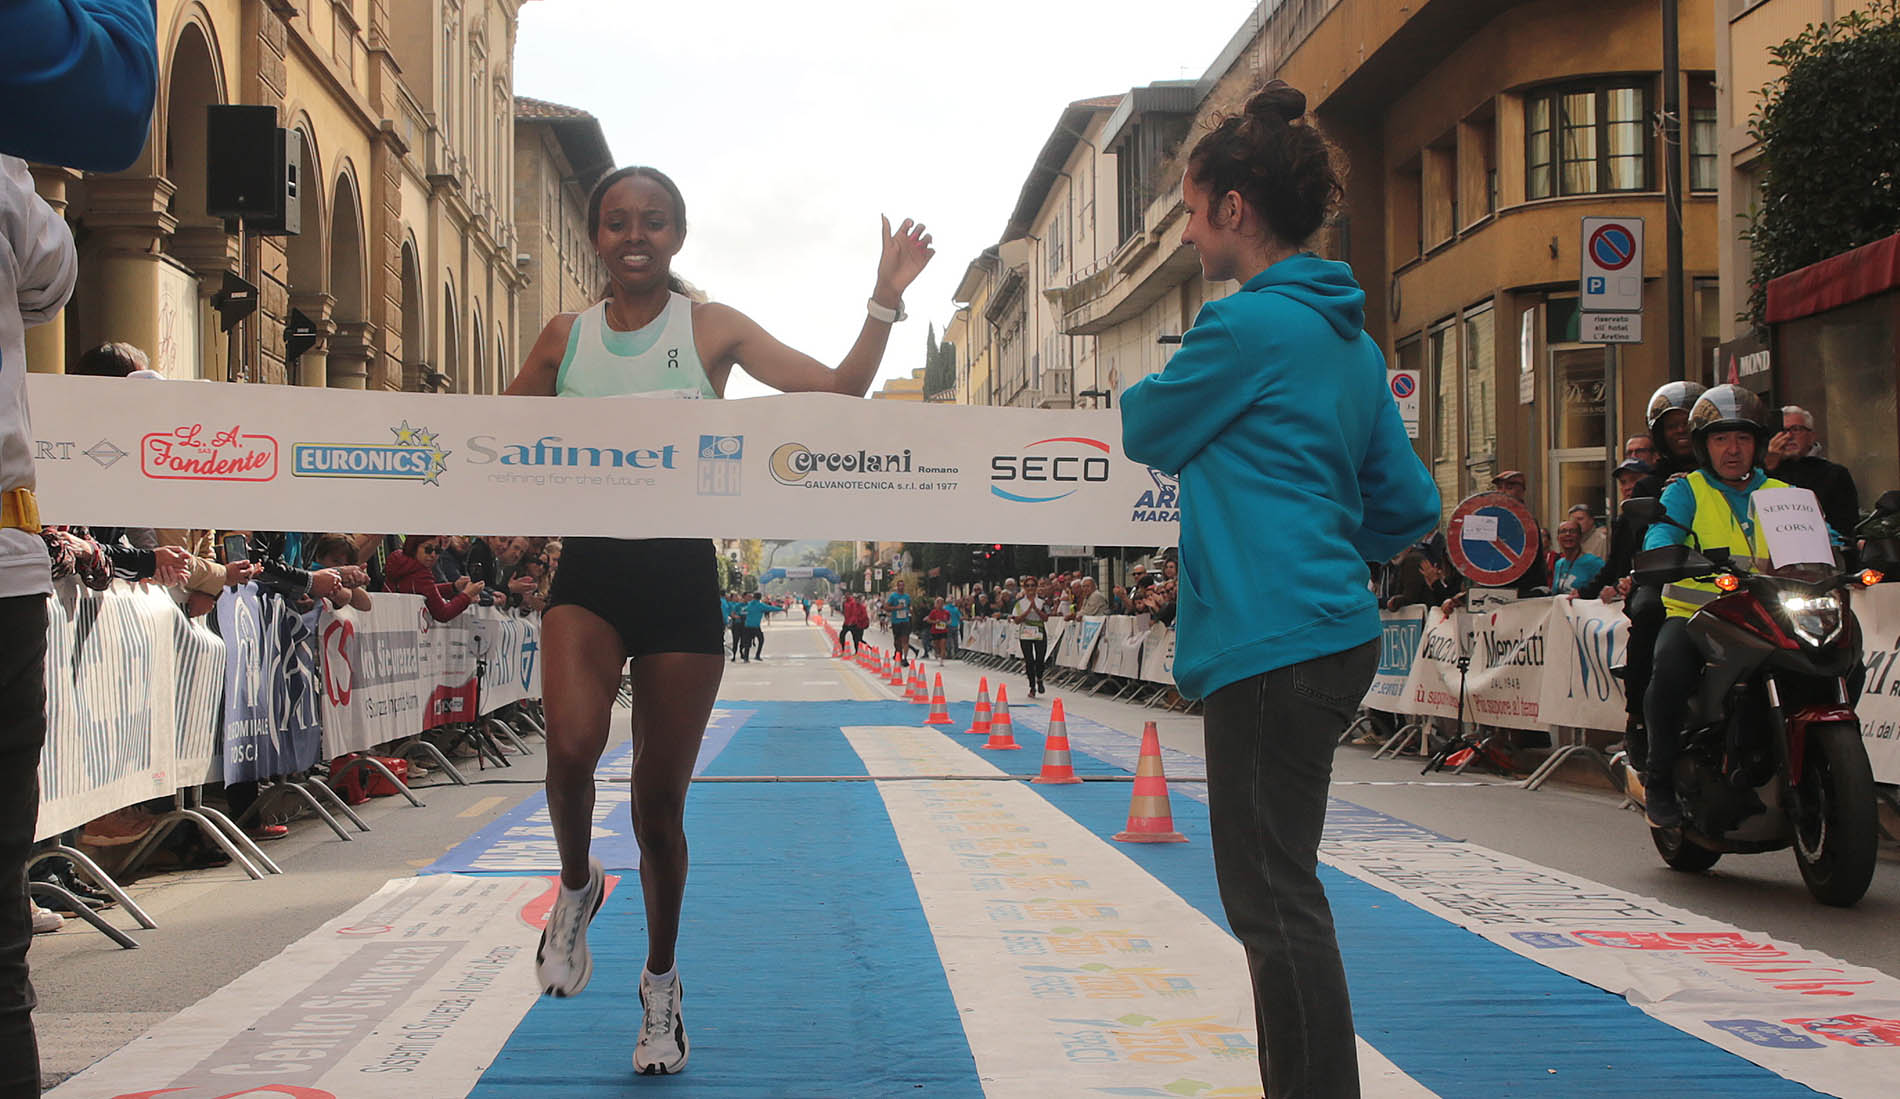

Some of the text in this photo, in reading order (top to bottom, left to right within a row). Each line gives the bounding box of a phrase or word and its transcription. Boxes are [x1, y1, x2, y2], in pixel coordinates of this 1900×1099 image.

[149, 438, 272, 475] Fondente
[301, 448, 426, 472] EURONICS
[465, 435, 681, 470] Safimet
[918, 466, 959, 474] Romano
[991, 456, 1109, 482] SECO
[487, 472, 545, 487] refining
[551, 473, 573, 485] for
[605, 475, 657, 488] future
[804, 481, 895, 491] GALVANOTECNICA
[919, 482, 934, 491] dal
[936, 482, 958, 491] 1977
[1763, 503, 1815, 513] SERVIZIO
[1775, 522, 1815, 533] CORSA
